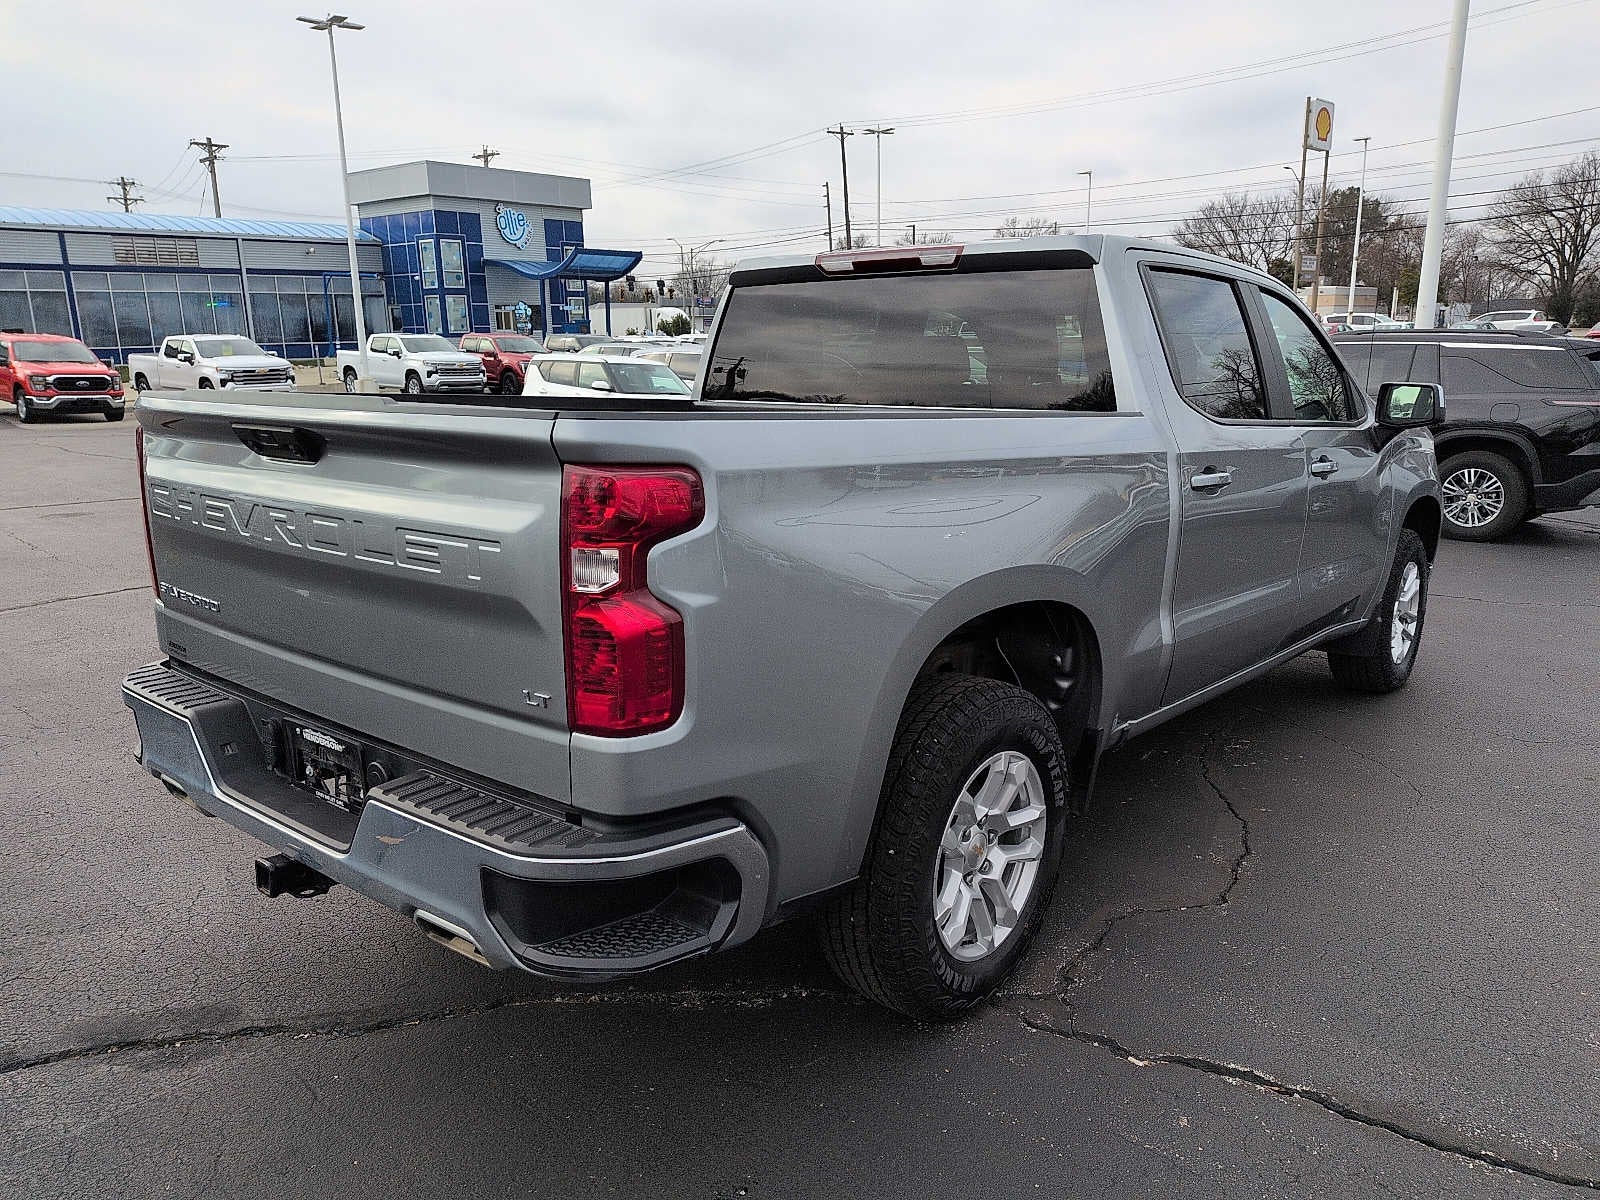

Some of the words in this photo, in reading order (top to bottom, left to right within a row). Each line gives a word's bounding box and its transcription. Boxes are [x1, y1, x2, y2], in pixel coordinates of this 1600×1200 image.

[498, 208, 526, 236] ollie
[150, 483, 502, 581] CHEVROLET
[522, 689, 552, 709] LT
